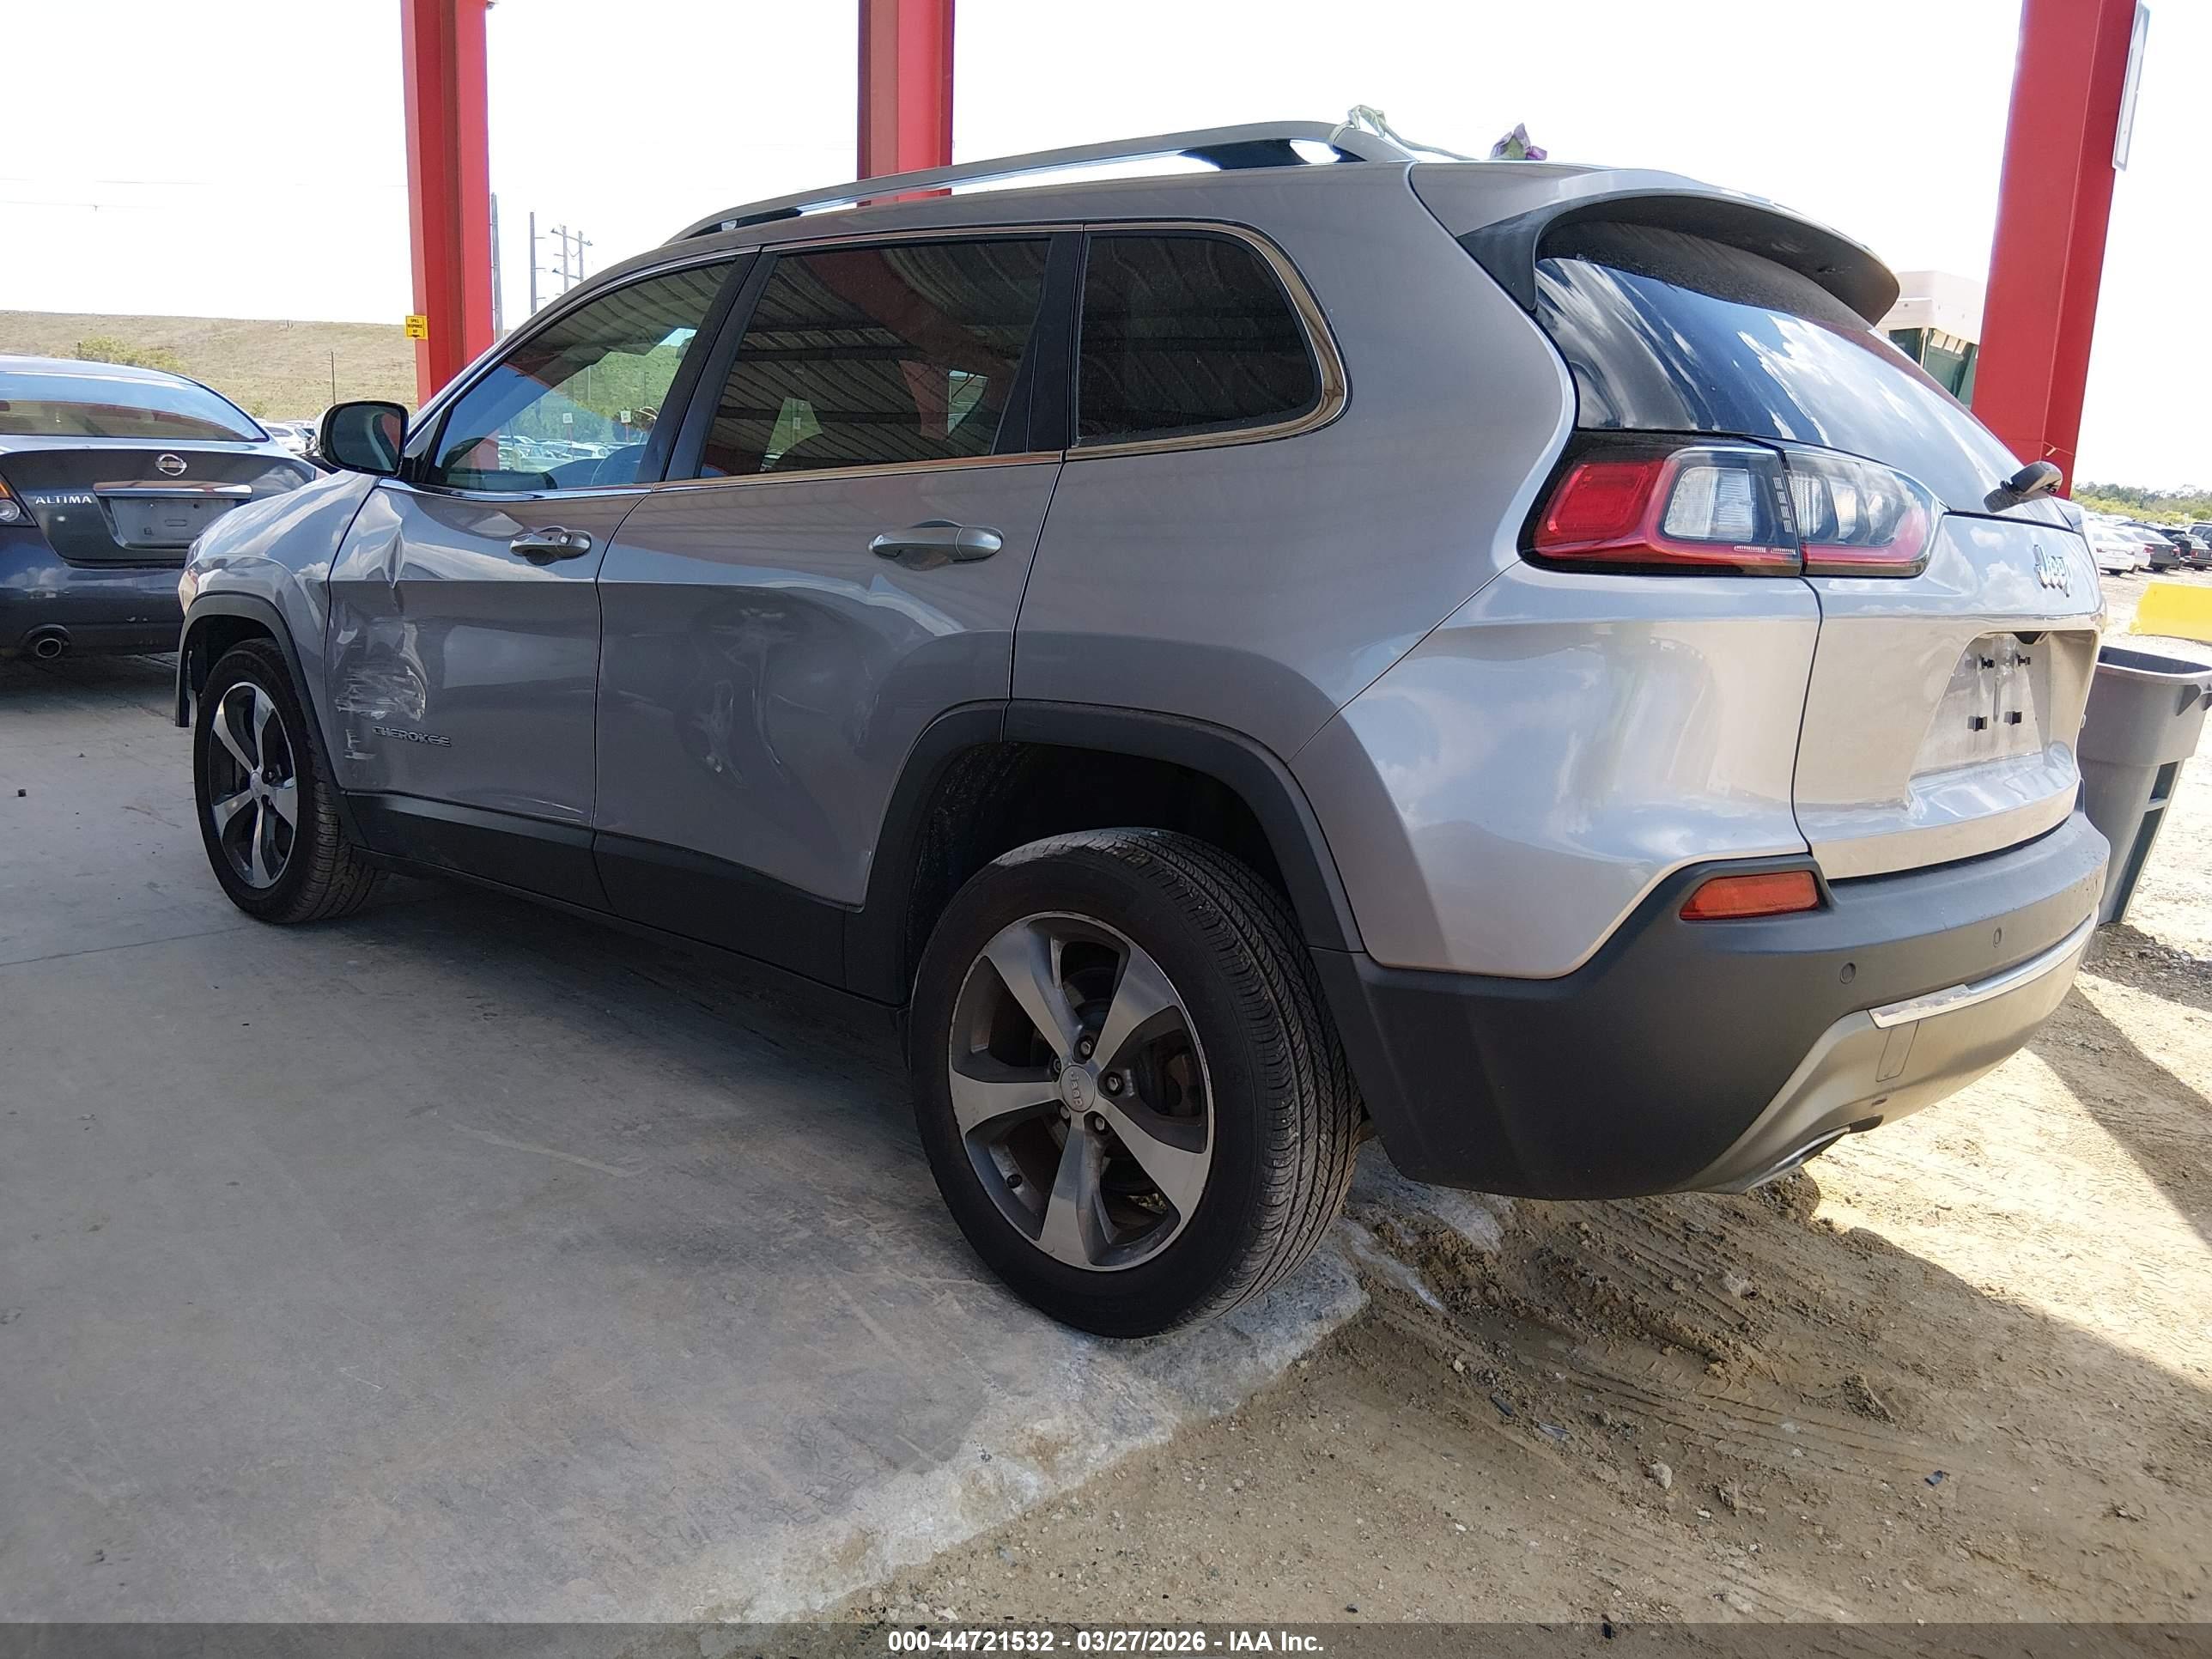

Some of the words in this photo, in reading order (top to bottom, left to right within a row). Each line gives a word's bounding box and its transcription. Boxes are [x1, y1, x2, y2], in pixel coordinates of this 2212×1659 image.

[35, 495, 93, 505] ALTIMA
[2033, 544, 2070, 598] Jeep
[372, 726, 452, 747] CHEROKEE
[1069, 1071, 1083, 1107] Jeep
